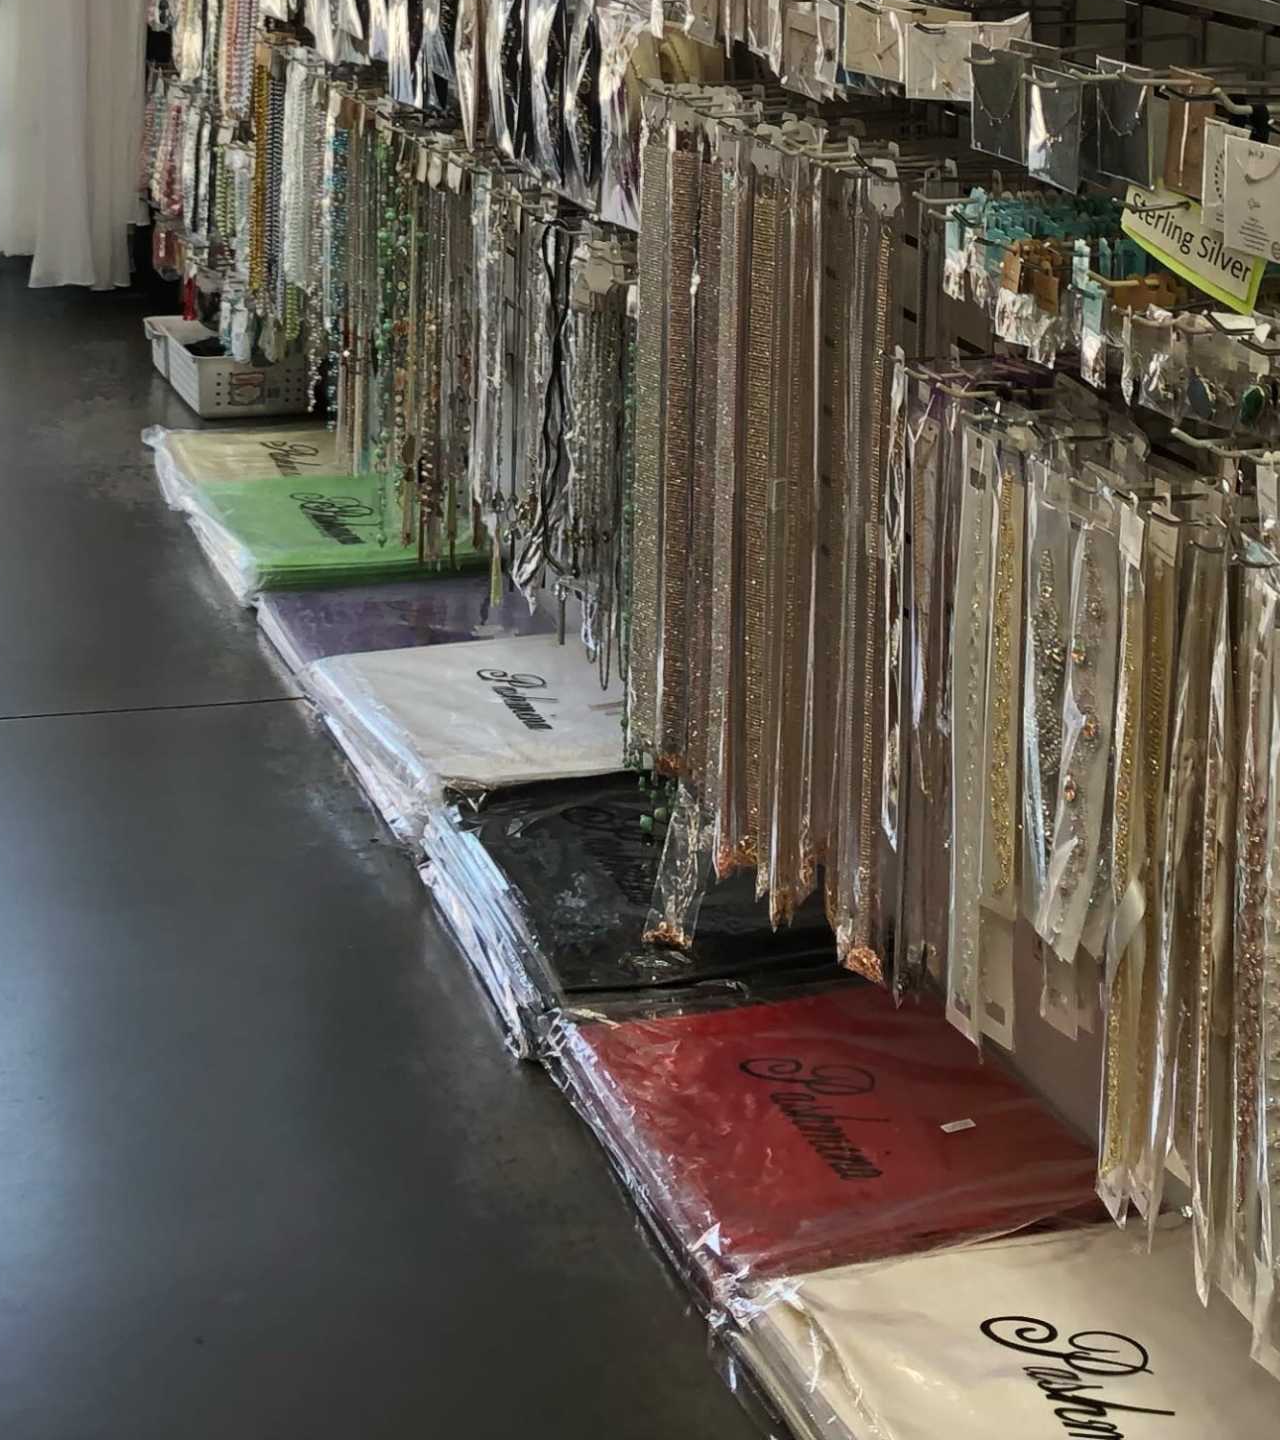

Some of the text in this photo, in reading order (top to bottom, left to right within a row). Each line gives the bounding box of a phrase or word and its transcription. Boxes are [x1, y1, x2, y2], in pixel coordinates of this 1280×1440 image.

[1131, 192, 1195, 256] Sterling
[1197, 235, 1252, 283] Silver
[738, 1056, 892, 1181] Pashmina
